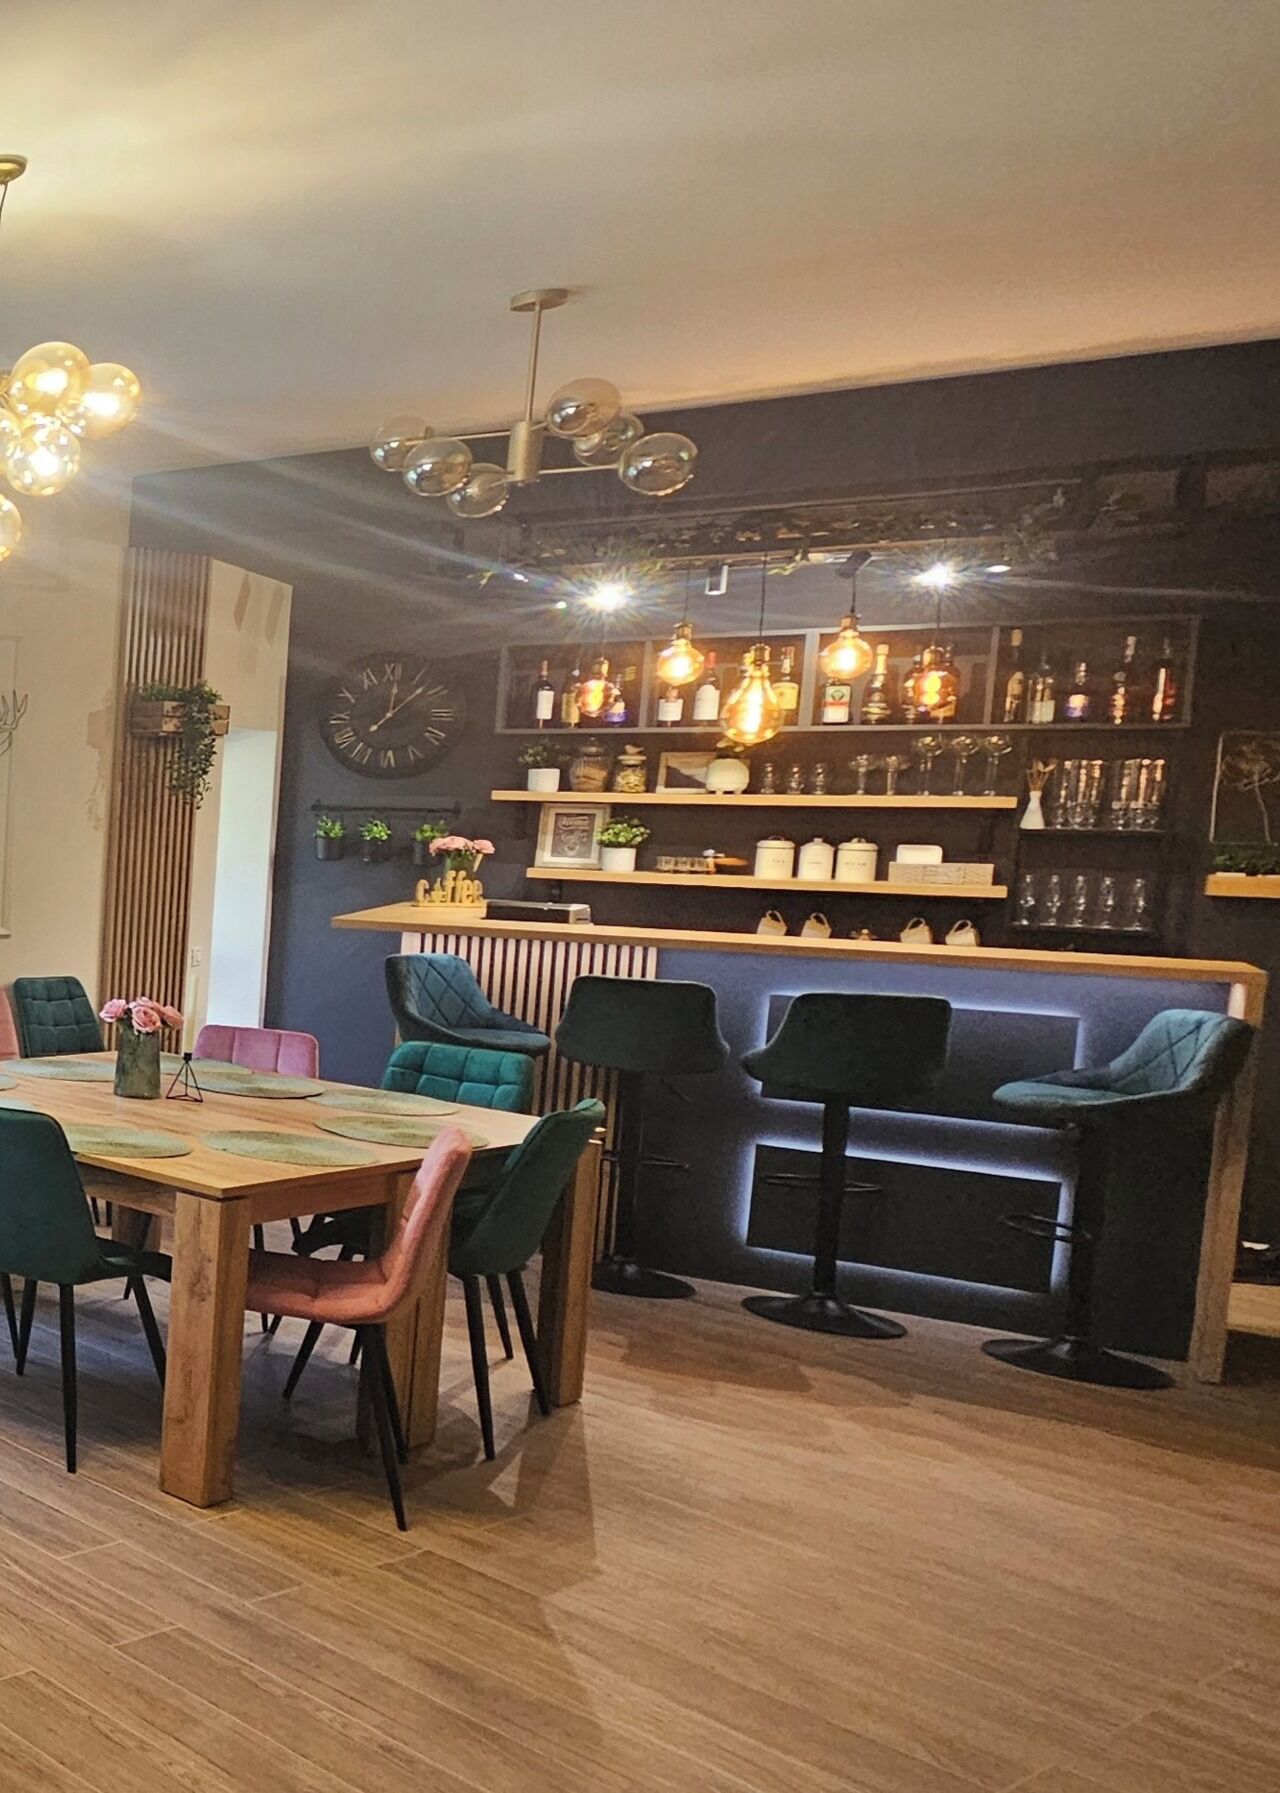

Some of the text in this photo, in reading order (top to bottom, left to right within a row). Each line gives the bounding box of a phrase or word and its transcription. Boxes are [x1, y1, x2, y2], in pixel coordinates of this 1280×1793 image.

[329, 710, 351, 724] IX
[430, 709, 454, 721] III
[408, 745, 424, 761] V
